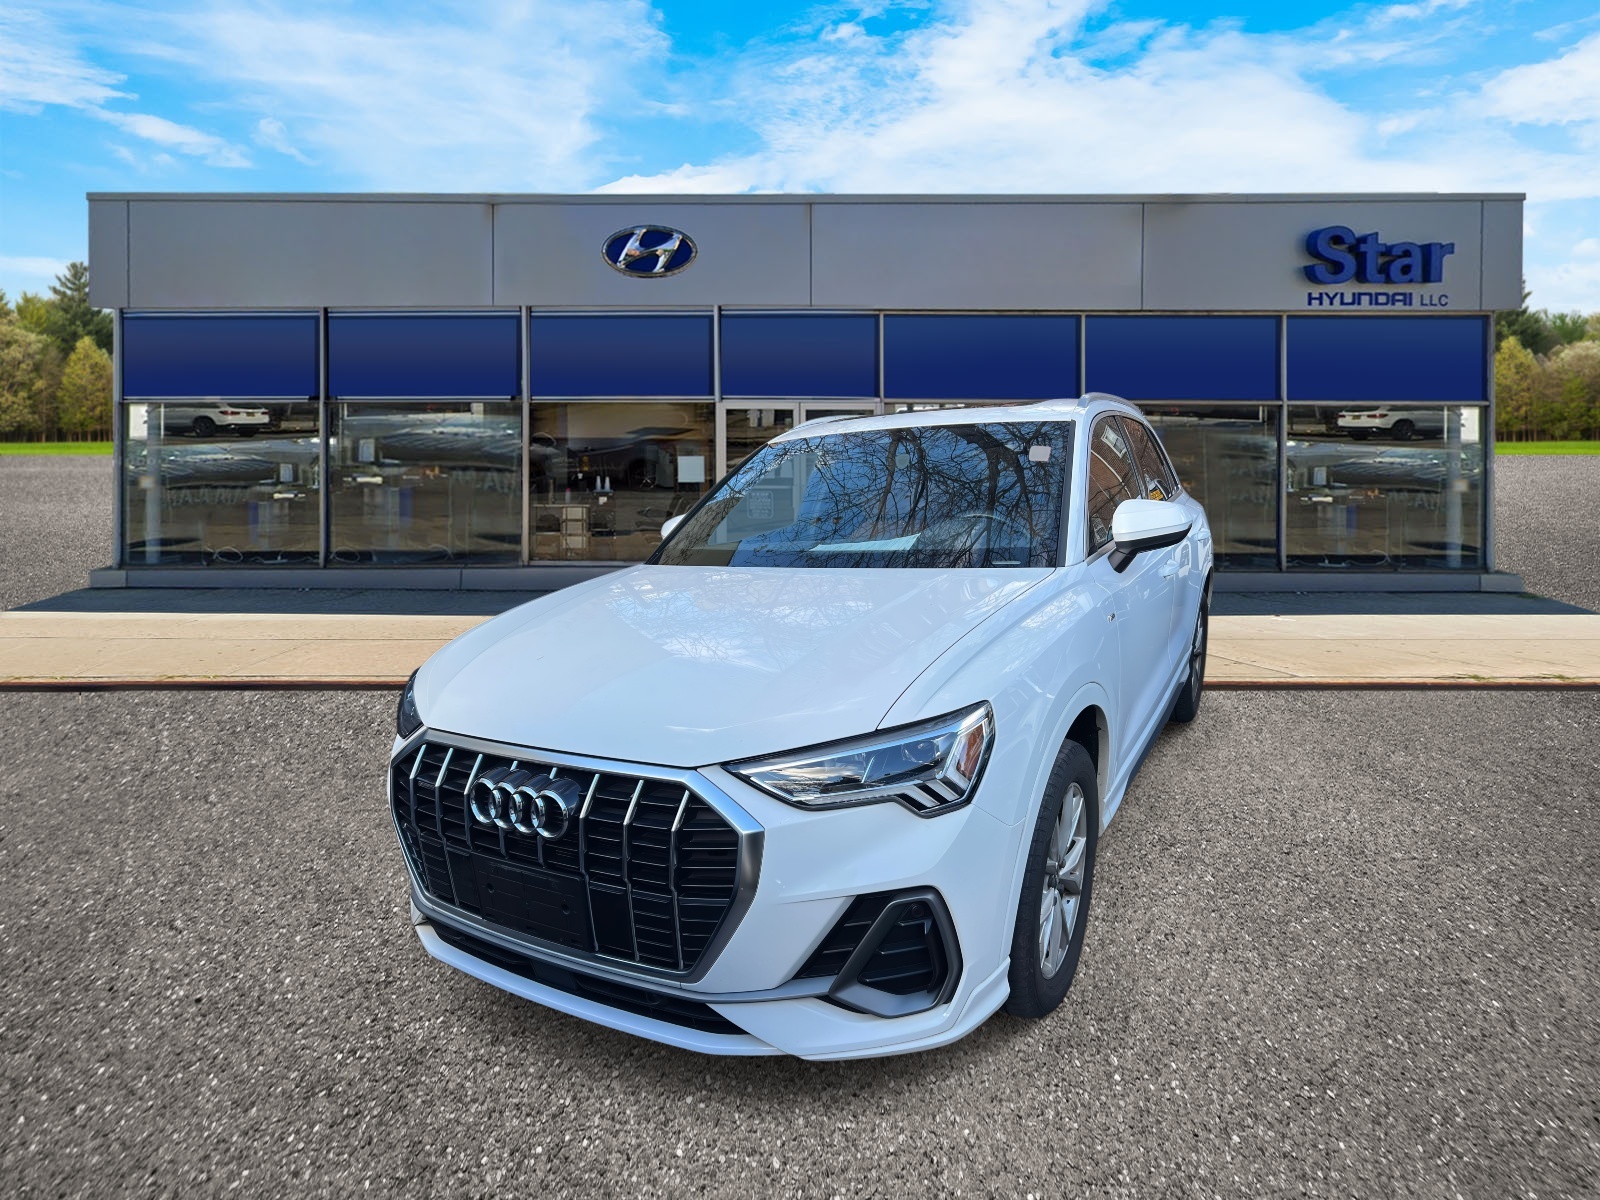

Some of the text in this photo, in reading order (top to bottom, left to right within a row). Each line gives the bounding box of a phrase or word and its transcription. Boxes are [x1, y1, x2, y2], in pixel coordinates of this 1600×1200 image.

[1304, 225, 1455, 284] Star
[1307, 292, 1449, 307] HYUNDAI LLC
